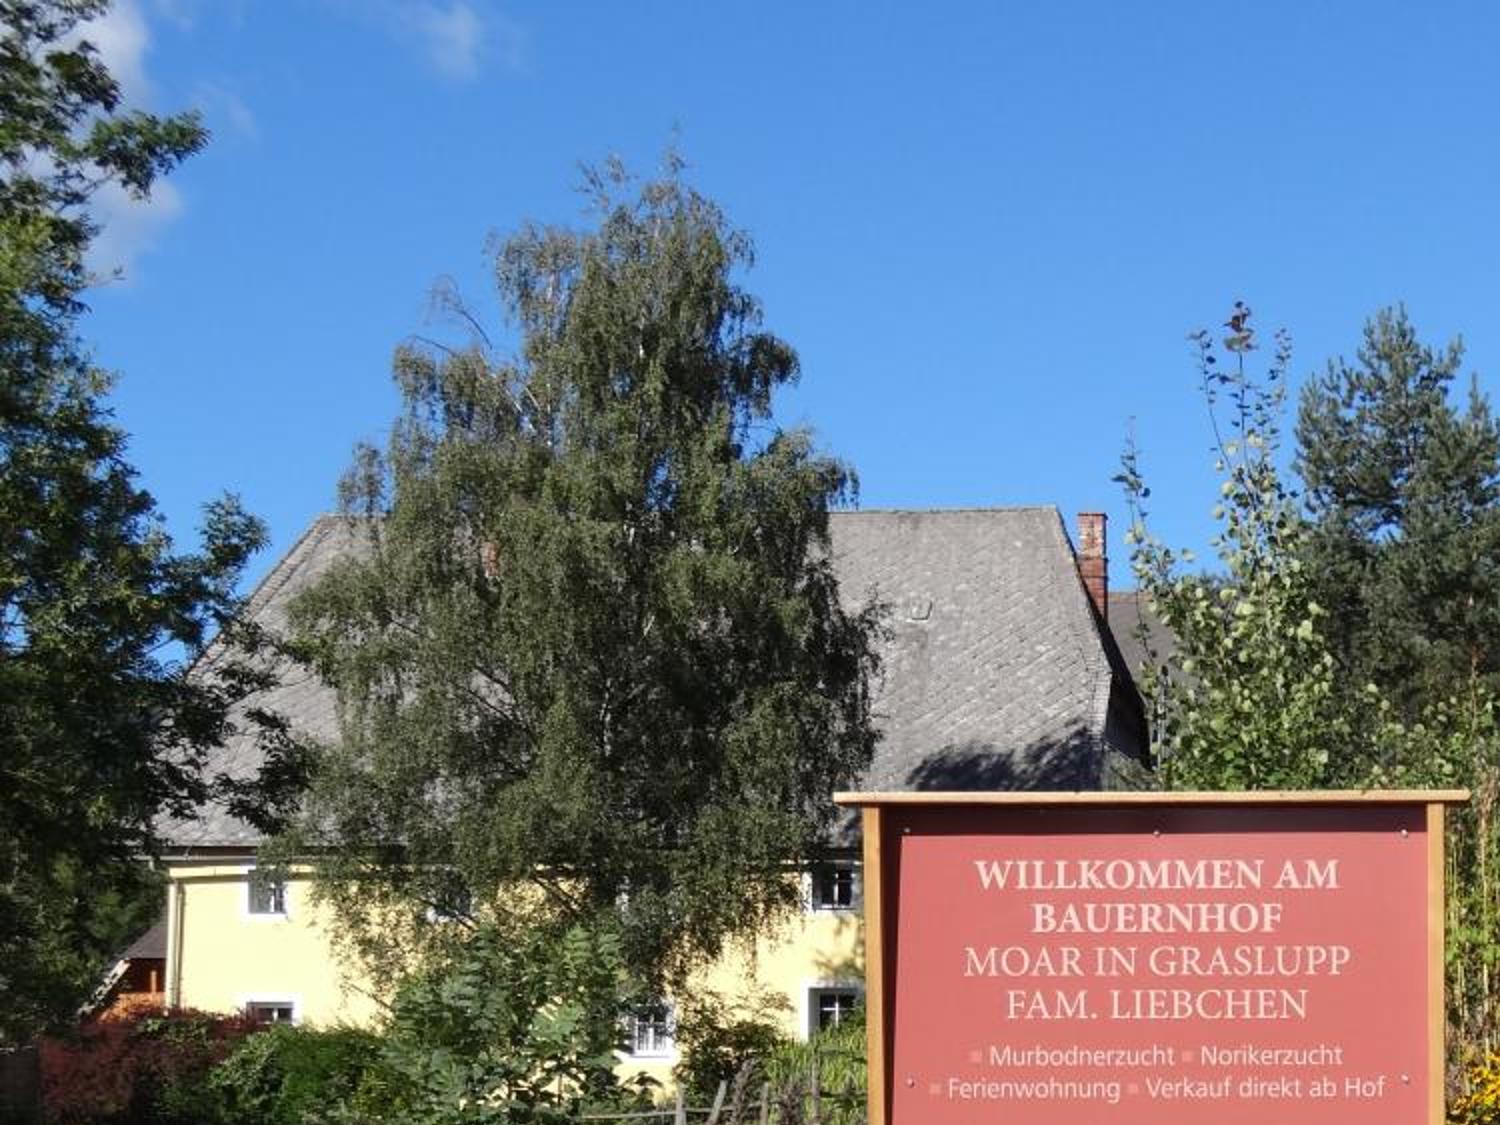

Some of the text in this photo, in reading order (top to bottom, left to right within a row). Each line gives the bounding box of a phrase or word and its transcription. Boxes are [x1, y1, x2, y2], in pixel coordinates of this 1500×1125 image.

[975, 859, 1340, 890] WILLKOMMEN AM
[1031, 902, 1283, 933] BAUERNHOF
[963, 945, 1351, 976] MOAR IN GRASLUPP
[1007, 989, 1309, 1020] FAM. LIEBCHEN
[989, 1044, 1344, 1067] Murbodnerzucht Norikerzucht
[948, 1076, 1386, 1103] Ferienwohnung Verkauf direkt ab Hof
